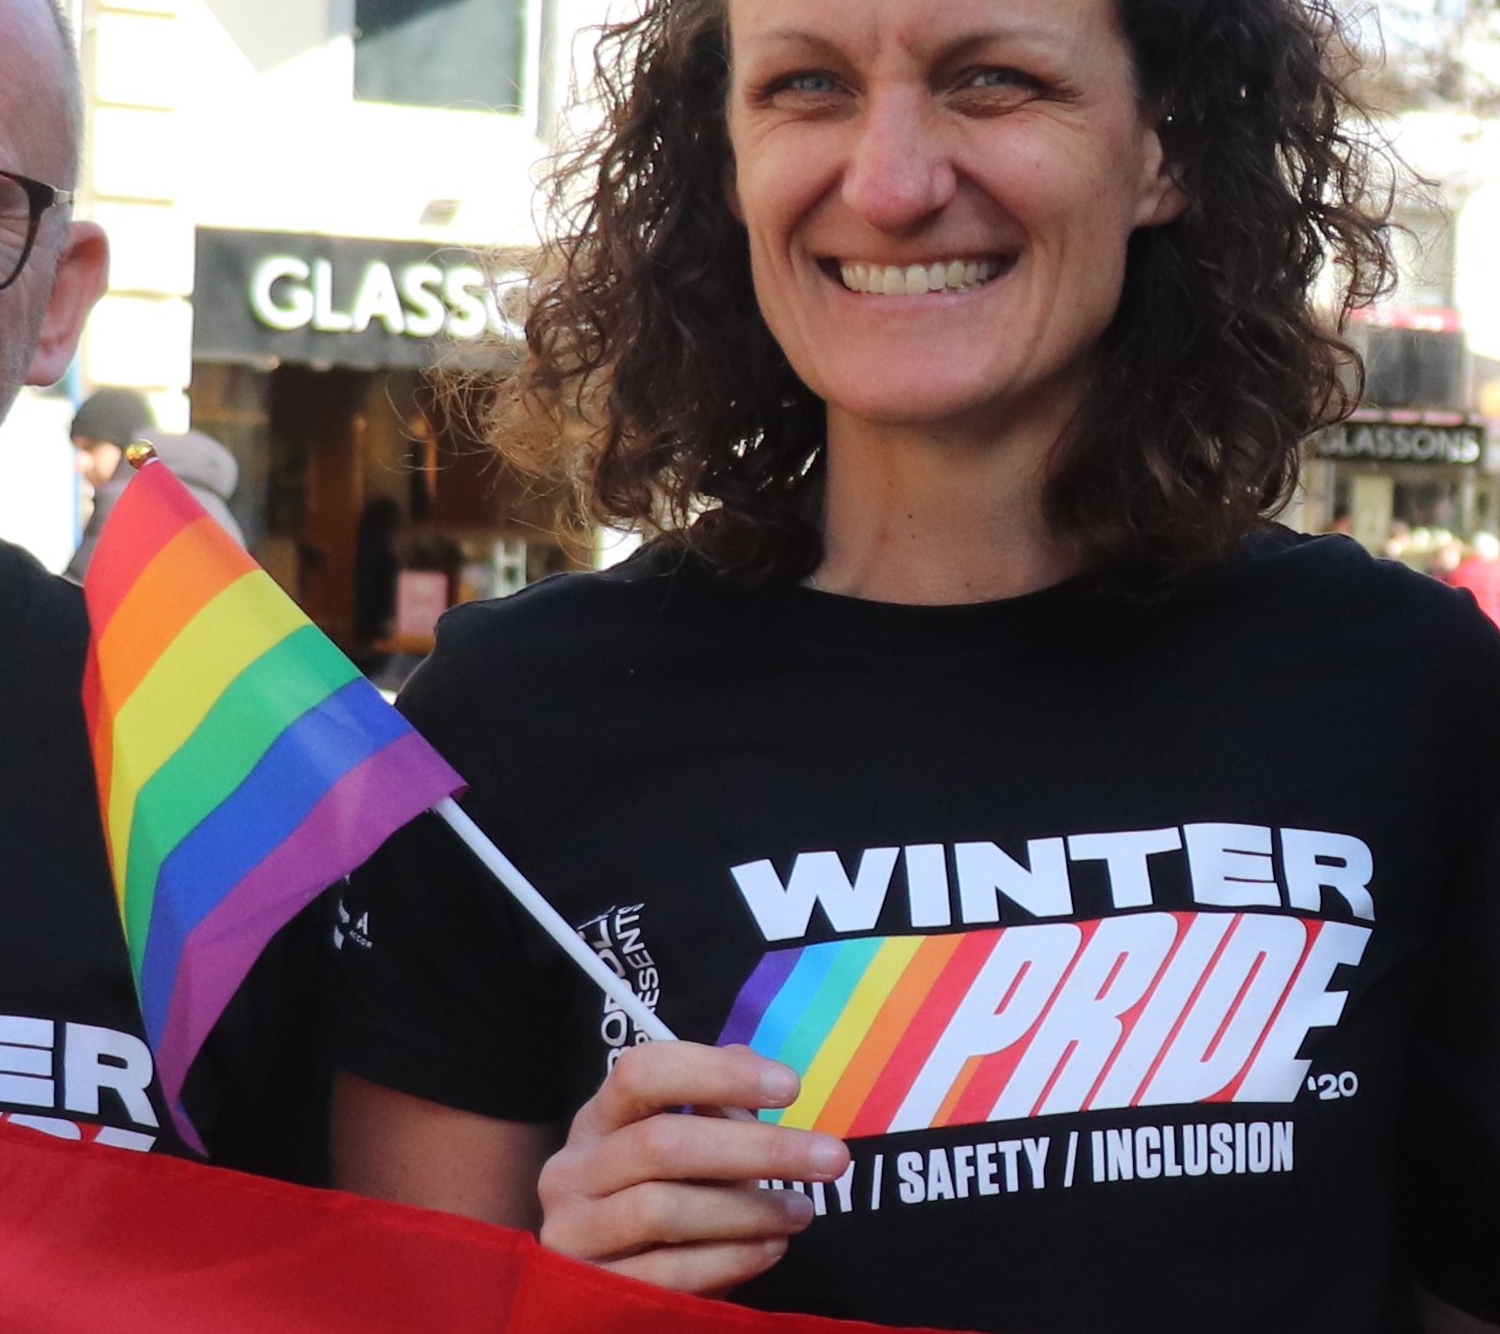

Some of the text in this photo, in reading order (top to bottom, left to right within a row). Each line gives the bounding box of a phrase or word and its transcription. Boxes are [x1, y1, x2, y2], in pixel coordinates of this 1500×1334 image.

[730, 822, 1375, 941] WINTER
[886, 912, 1373, 1133] PRIDE
[899, 1136, 1051, 1204] SAFETY
[1091, 1121, 1294, 1183] INCLUSION
